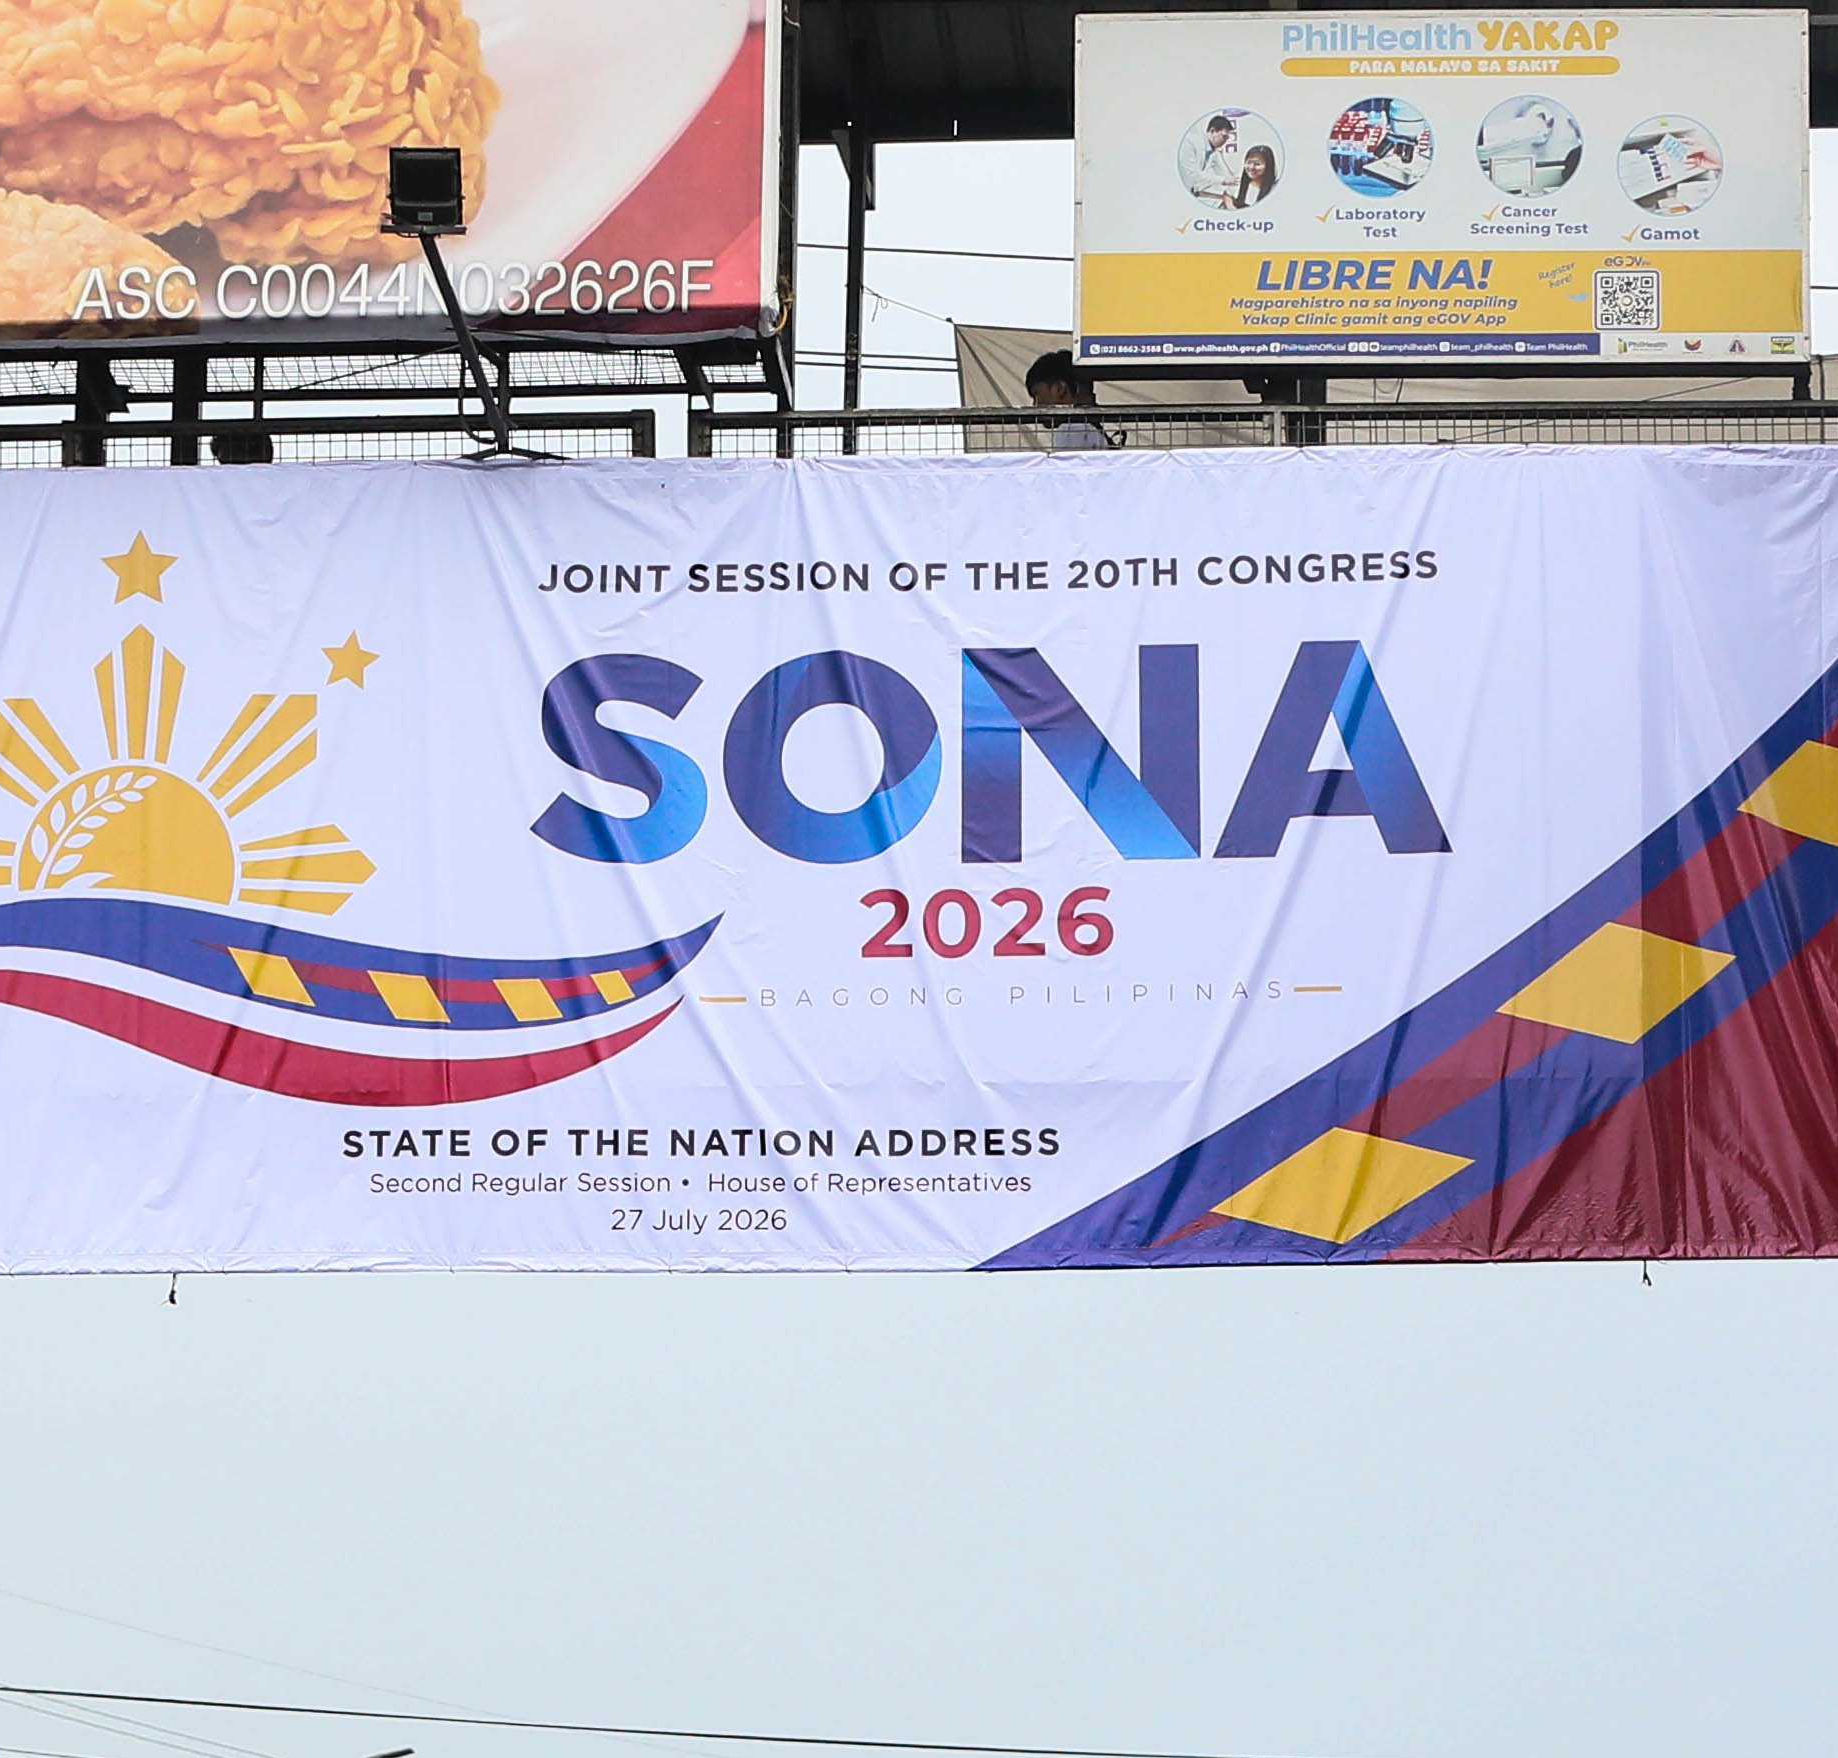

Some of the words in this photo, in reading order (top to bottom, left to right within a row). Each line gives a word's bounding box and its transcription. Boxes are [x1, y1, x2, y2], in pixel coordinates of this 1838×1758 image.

[1282, 21, 1472, 50] PhilHealth
[1477, 20, 1619, 51] YAKAP
[1349, 60, 1397, 73] PARA
[1401, 59, 1472, 73] MALAYO
[1478, 59, 1502, 72] SA
[1507, 58, 1560, 72] SAKIT
[1193, 218, 1274, 234] Check-up
[1335, 207, 1426, 222] Laboratory
[1502, 205, 1558, 218] Cancer
[1363, 226, 1397, 238] Test
[1470, 222, 1551, 237] Screening
[1555, 223, 1589, 235] Test
[1640, 227, 1700, 241] Gamot
[1256, 259, 1396, 291] LIBRE
[1408, 258, 1493, 291] NA!
[73, 264, 197, 321] ASC
[217, 259, 715, 320] C0044N032626F
[1230, 296, 1345, 311] Magparehistro
[1349, 299, 1369, 308] na
[1374, 299, 1391, 308] sa
[1396, 296, 1449, 310] inyong
[1453, 296, 1518, 310] napiling
[1242, 313, 1290, 327] Yakap
[1295, 312, 1337, 325] Clinic
[1341, 313, 1388, 328] gamit
[1392, 316, 1423, 327] ang
[1427, 313, 1471, 325] eGOV
[1475, 313, 1506, 327] App
[538, 562, 672, 594] JOINT
[687, 560, 871, 594] SESSION
[889, 561, 949, 592] OF
[965, 560, 1049, 591] THE
[1067, 557, 1179, 590] 20TH
[1196, 550, 1439, 587] CONGRESS
[529, 639, 1455, 865] SONA
[859, 885, 1116, 960] 2026
[759, 984, 966, 1010] BAGONG
[1009, 979, 1285, 1006] PILIPINAS
[342, 1128, 472, 1160] STATE
[491, 1128, 549, 1159] OF
[567, 1128, 650, 1158] THE
[670, 1127, 835, 1158] NATION
[856, 1127, 1062, 1158] ADDRESS
[369, 1171, 463, 1195] Second
[471, 1171, 567, 1200] Regular
[577, 1171, 672, 1194] Session
[707, 1171, 786, 1195] House
[792, 1170, 821, 1195] of
[828, 1170, 1033, 1200] Representatives
[611, 1208, 644, 1232] 27
[650, 1207, 710, 1238] July
[718, 1208, 789, 1233] 2026
